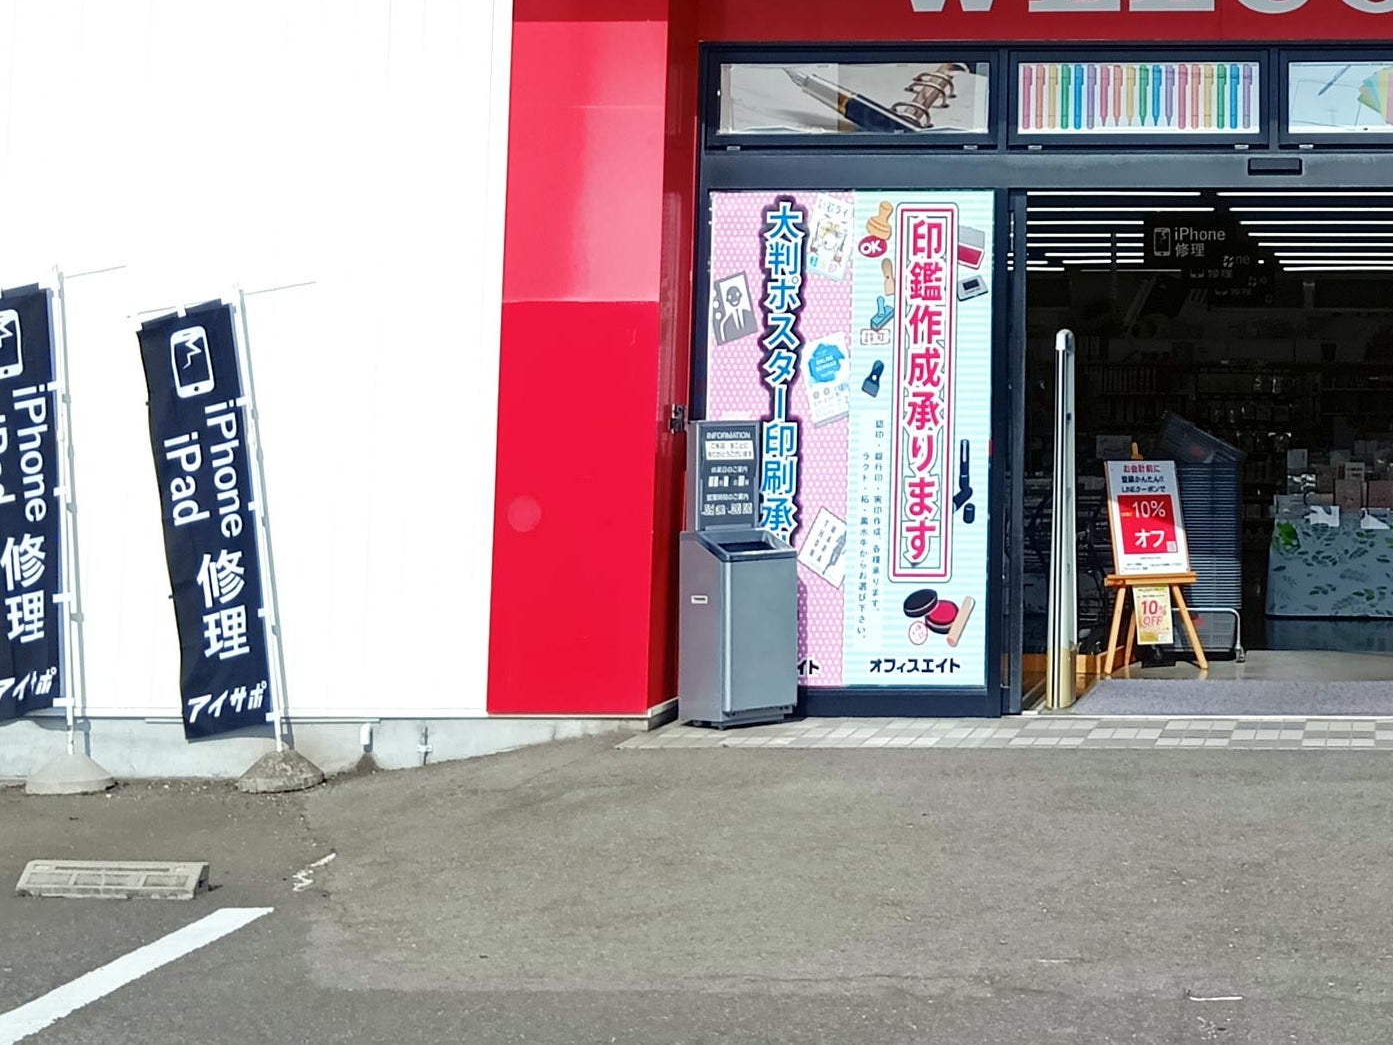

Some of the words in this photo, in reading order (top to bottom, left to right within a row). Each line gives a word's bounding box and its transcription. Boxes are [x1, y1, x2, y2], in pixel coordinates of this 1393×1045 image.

[860, 240, 883, 254] OK
[1174, 227, 1226, 241] iPhone
[1175, 243, 1205, 257] 修理
[905, 218, 945, 563] 印鑑作成承ります
[706, 431, 751, 440] INFORMATION
[12, 383, 48, 523] iPhone
[204, 398, 244, 539] iPhone
[163, 430, 211, 527] iPad
[1132, 500, 1166, 518] 10%
[1134, 528, 1165, 548] オフ
[0, 533, 46, 644] 修理
[196, 548, 250, 661] 修理
[869, 657, 961, 674] オフィスエイト
[187, 680, 267, 724] アイサポ
